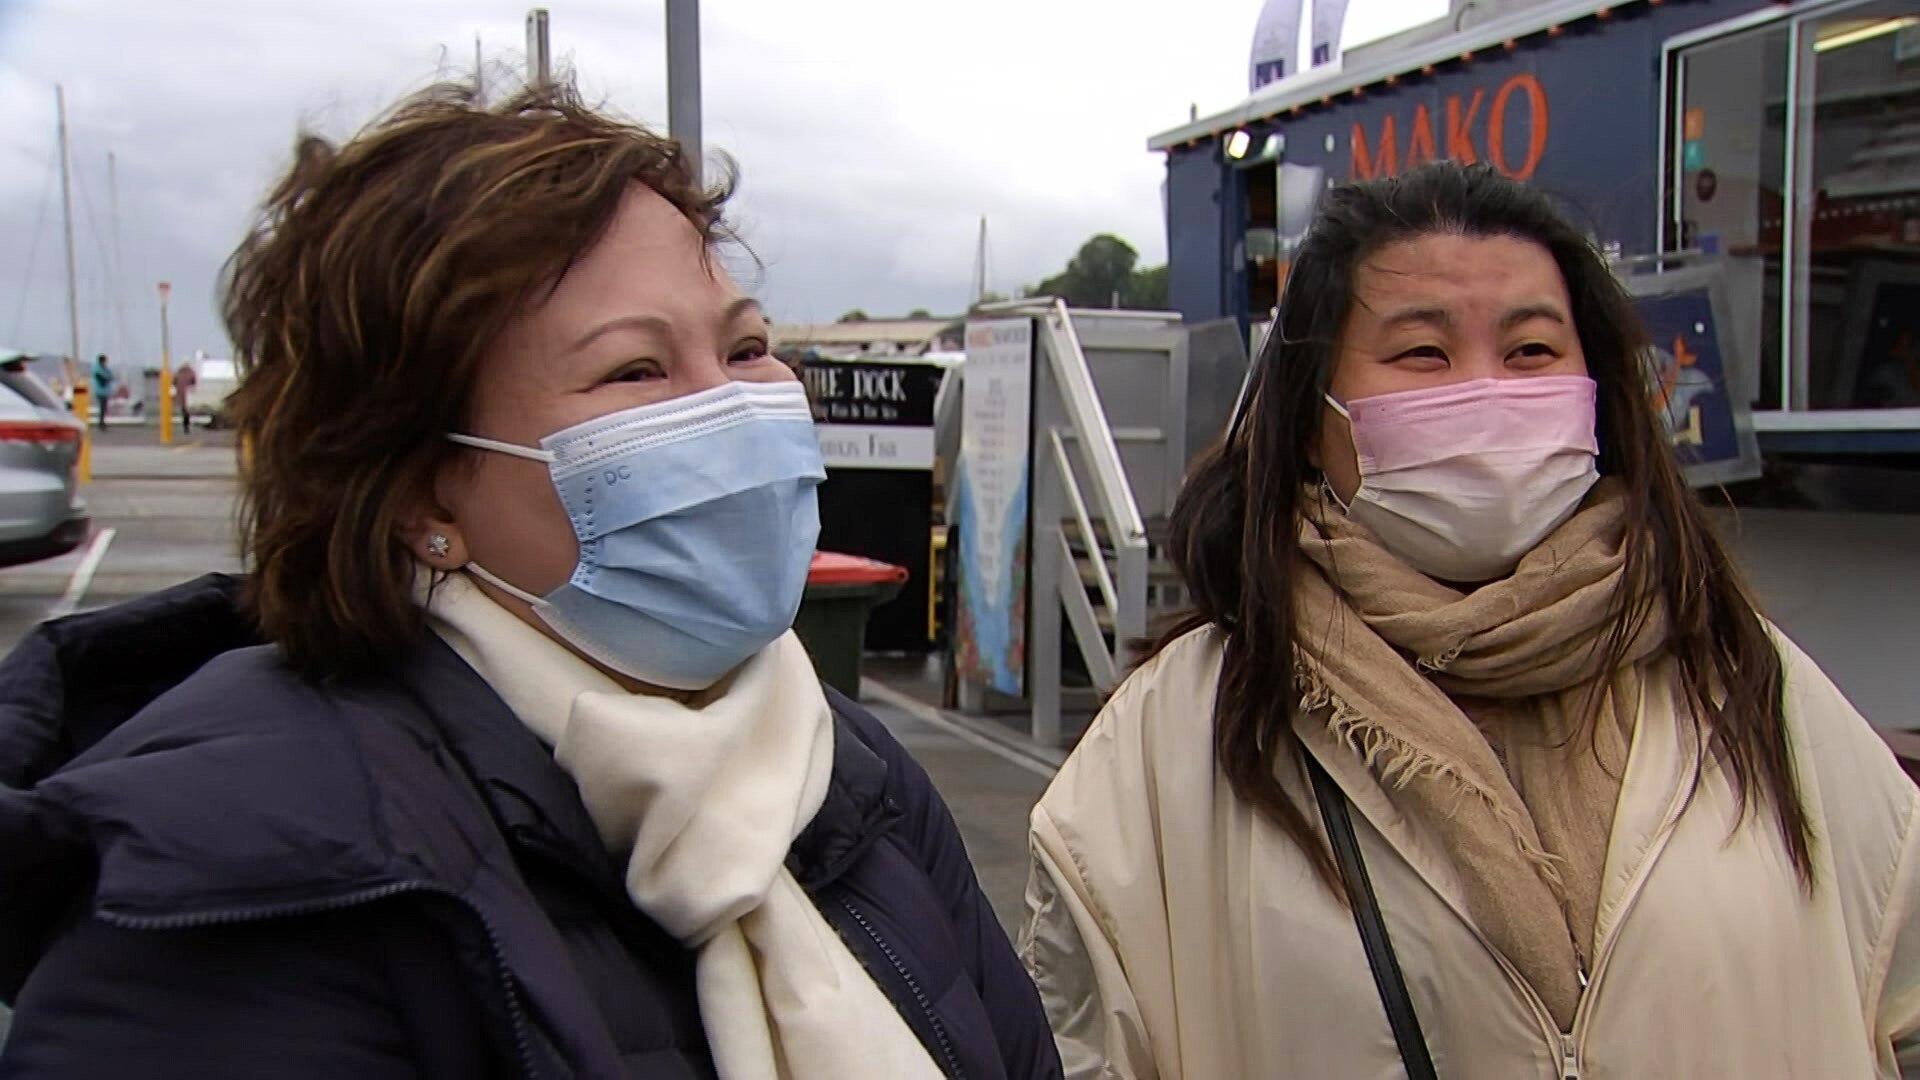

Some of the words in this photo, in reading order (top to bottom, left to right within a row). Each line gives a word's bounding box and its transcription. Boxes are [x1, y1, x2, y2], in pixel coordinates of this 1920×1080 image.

[1347, 72, 1548, 182] MAKO
[854, 369, 907, 401] DOCK
[603, 465, 631, 486] DC
